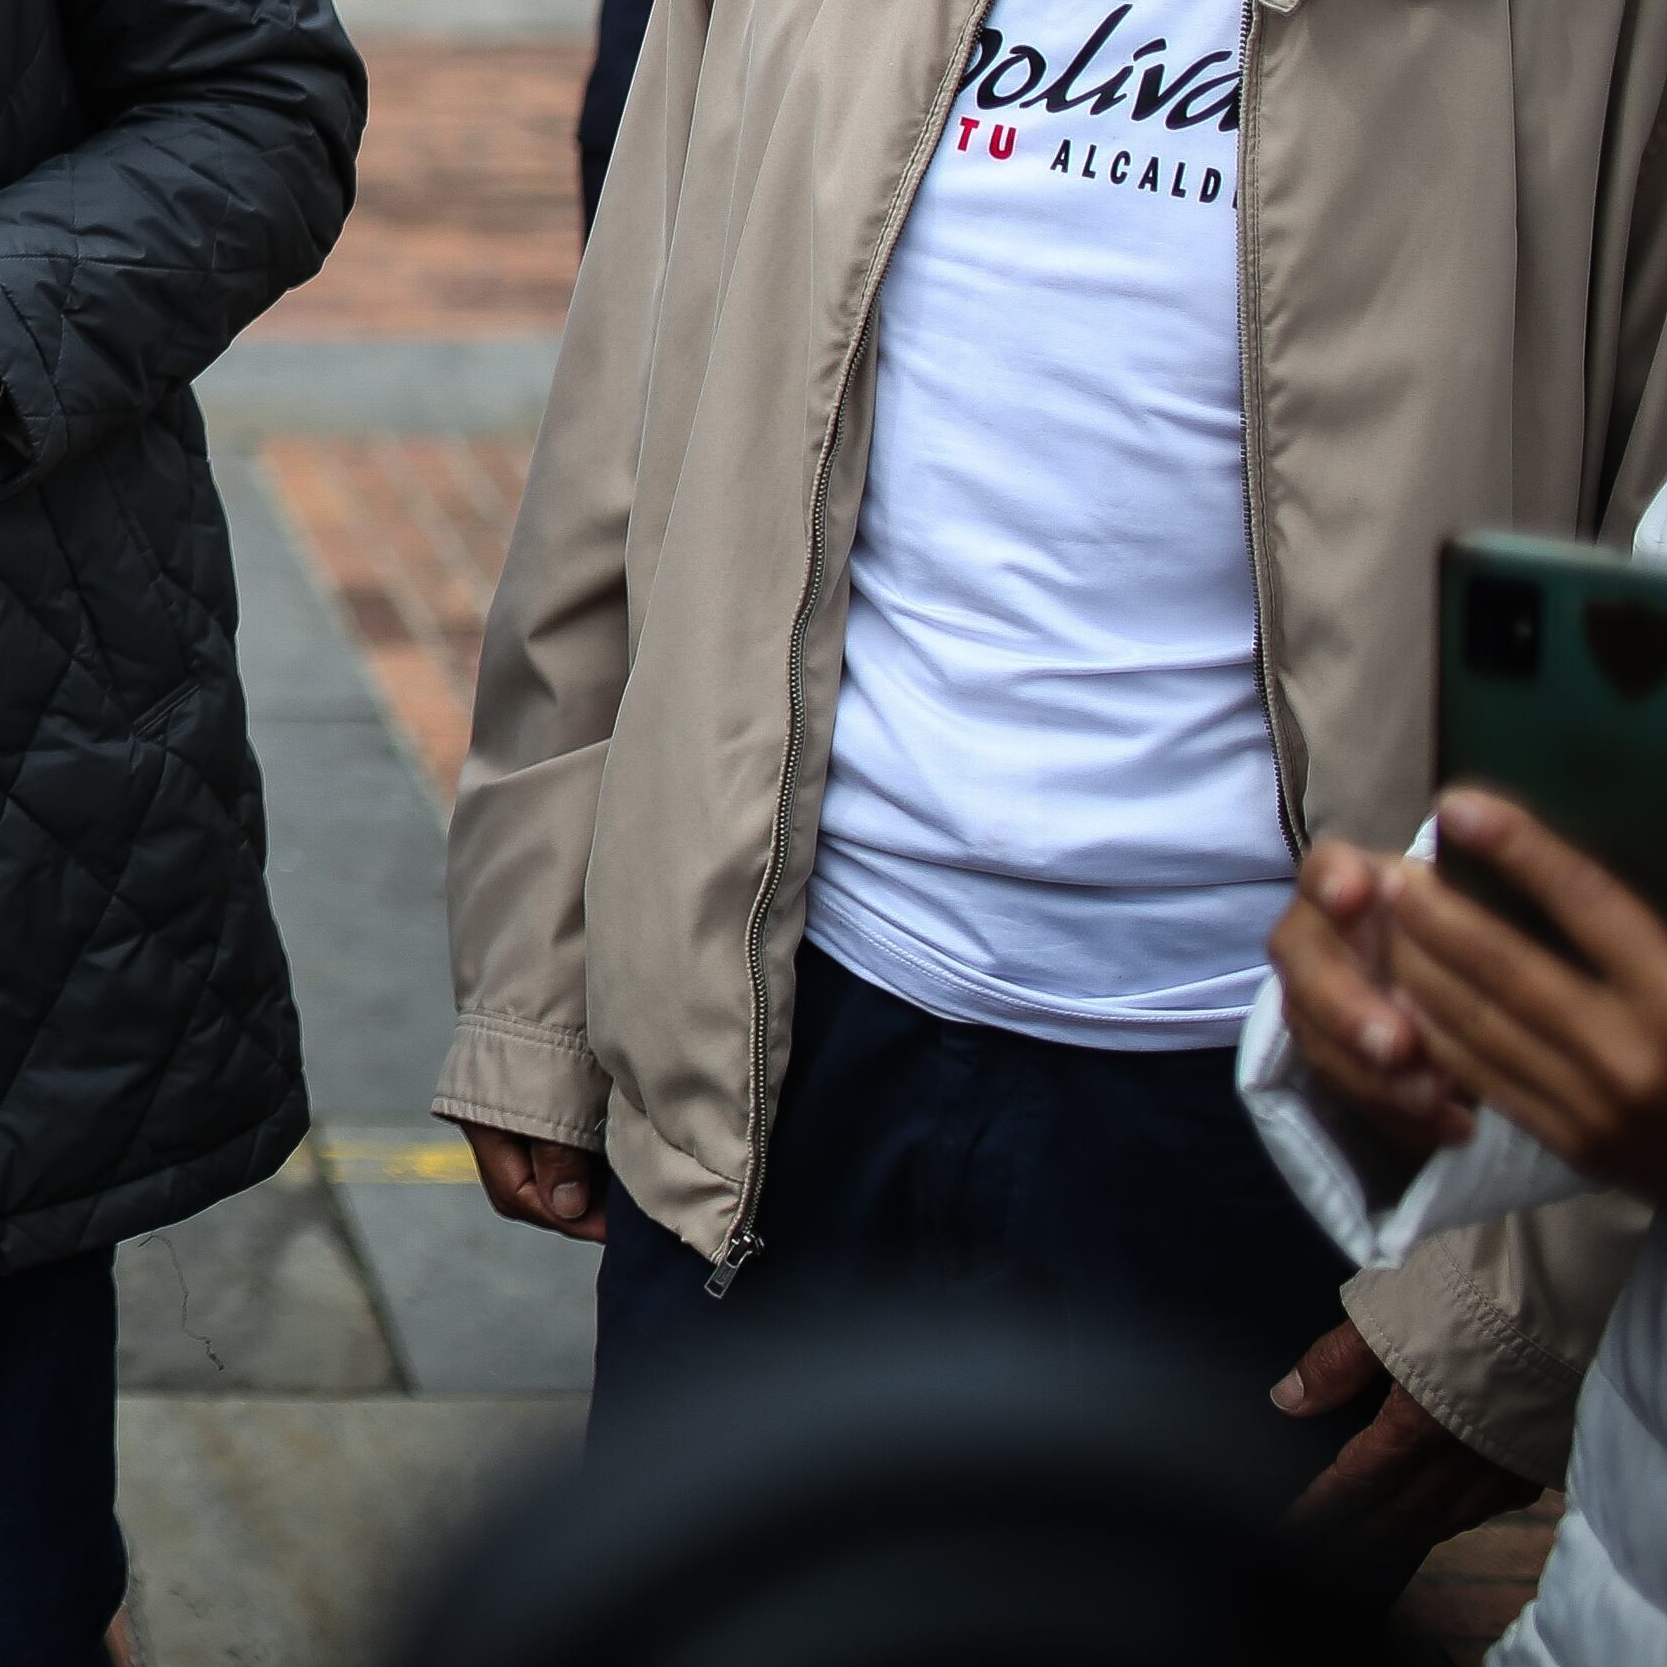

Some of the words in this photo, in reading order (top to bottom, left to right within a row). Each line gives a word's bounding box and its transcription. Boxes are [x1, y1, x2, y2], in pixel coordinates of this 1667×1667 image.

[959, 3, 1244, 133] olíva
[956, 116, 1018, 161] TU
[1050, 138, 1238, 211] ALCALD
